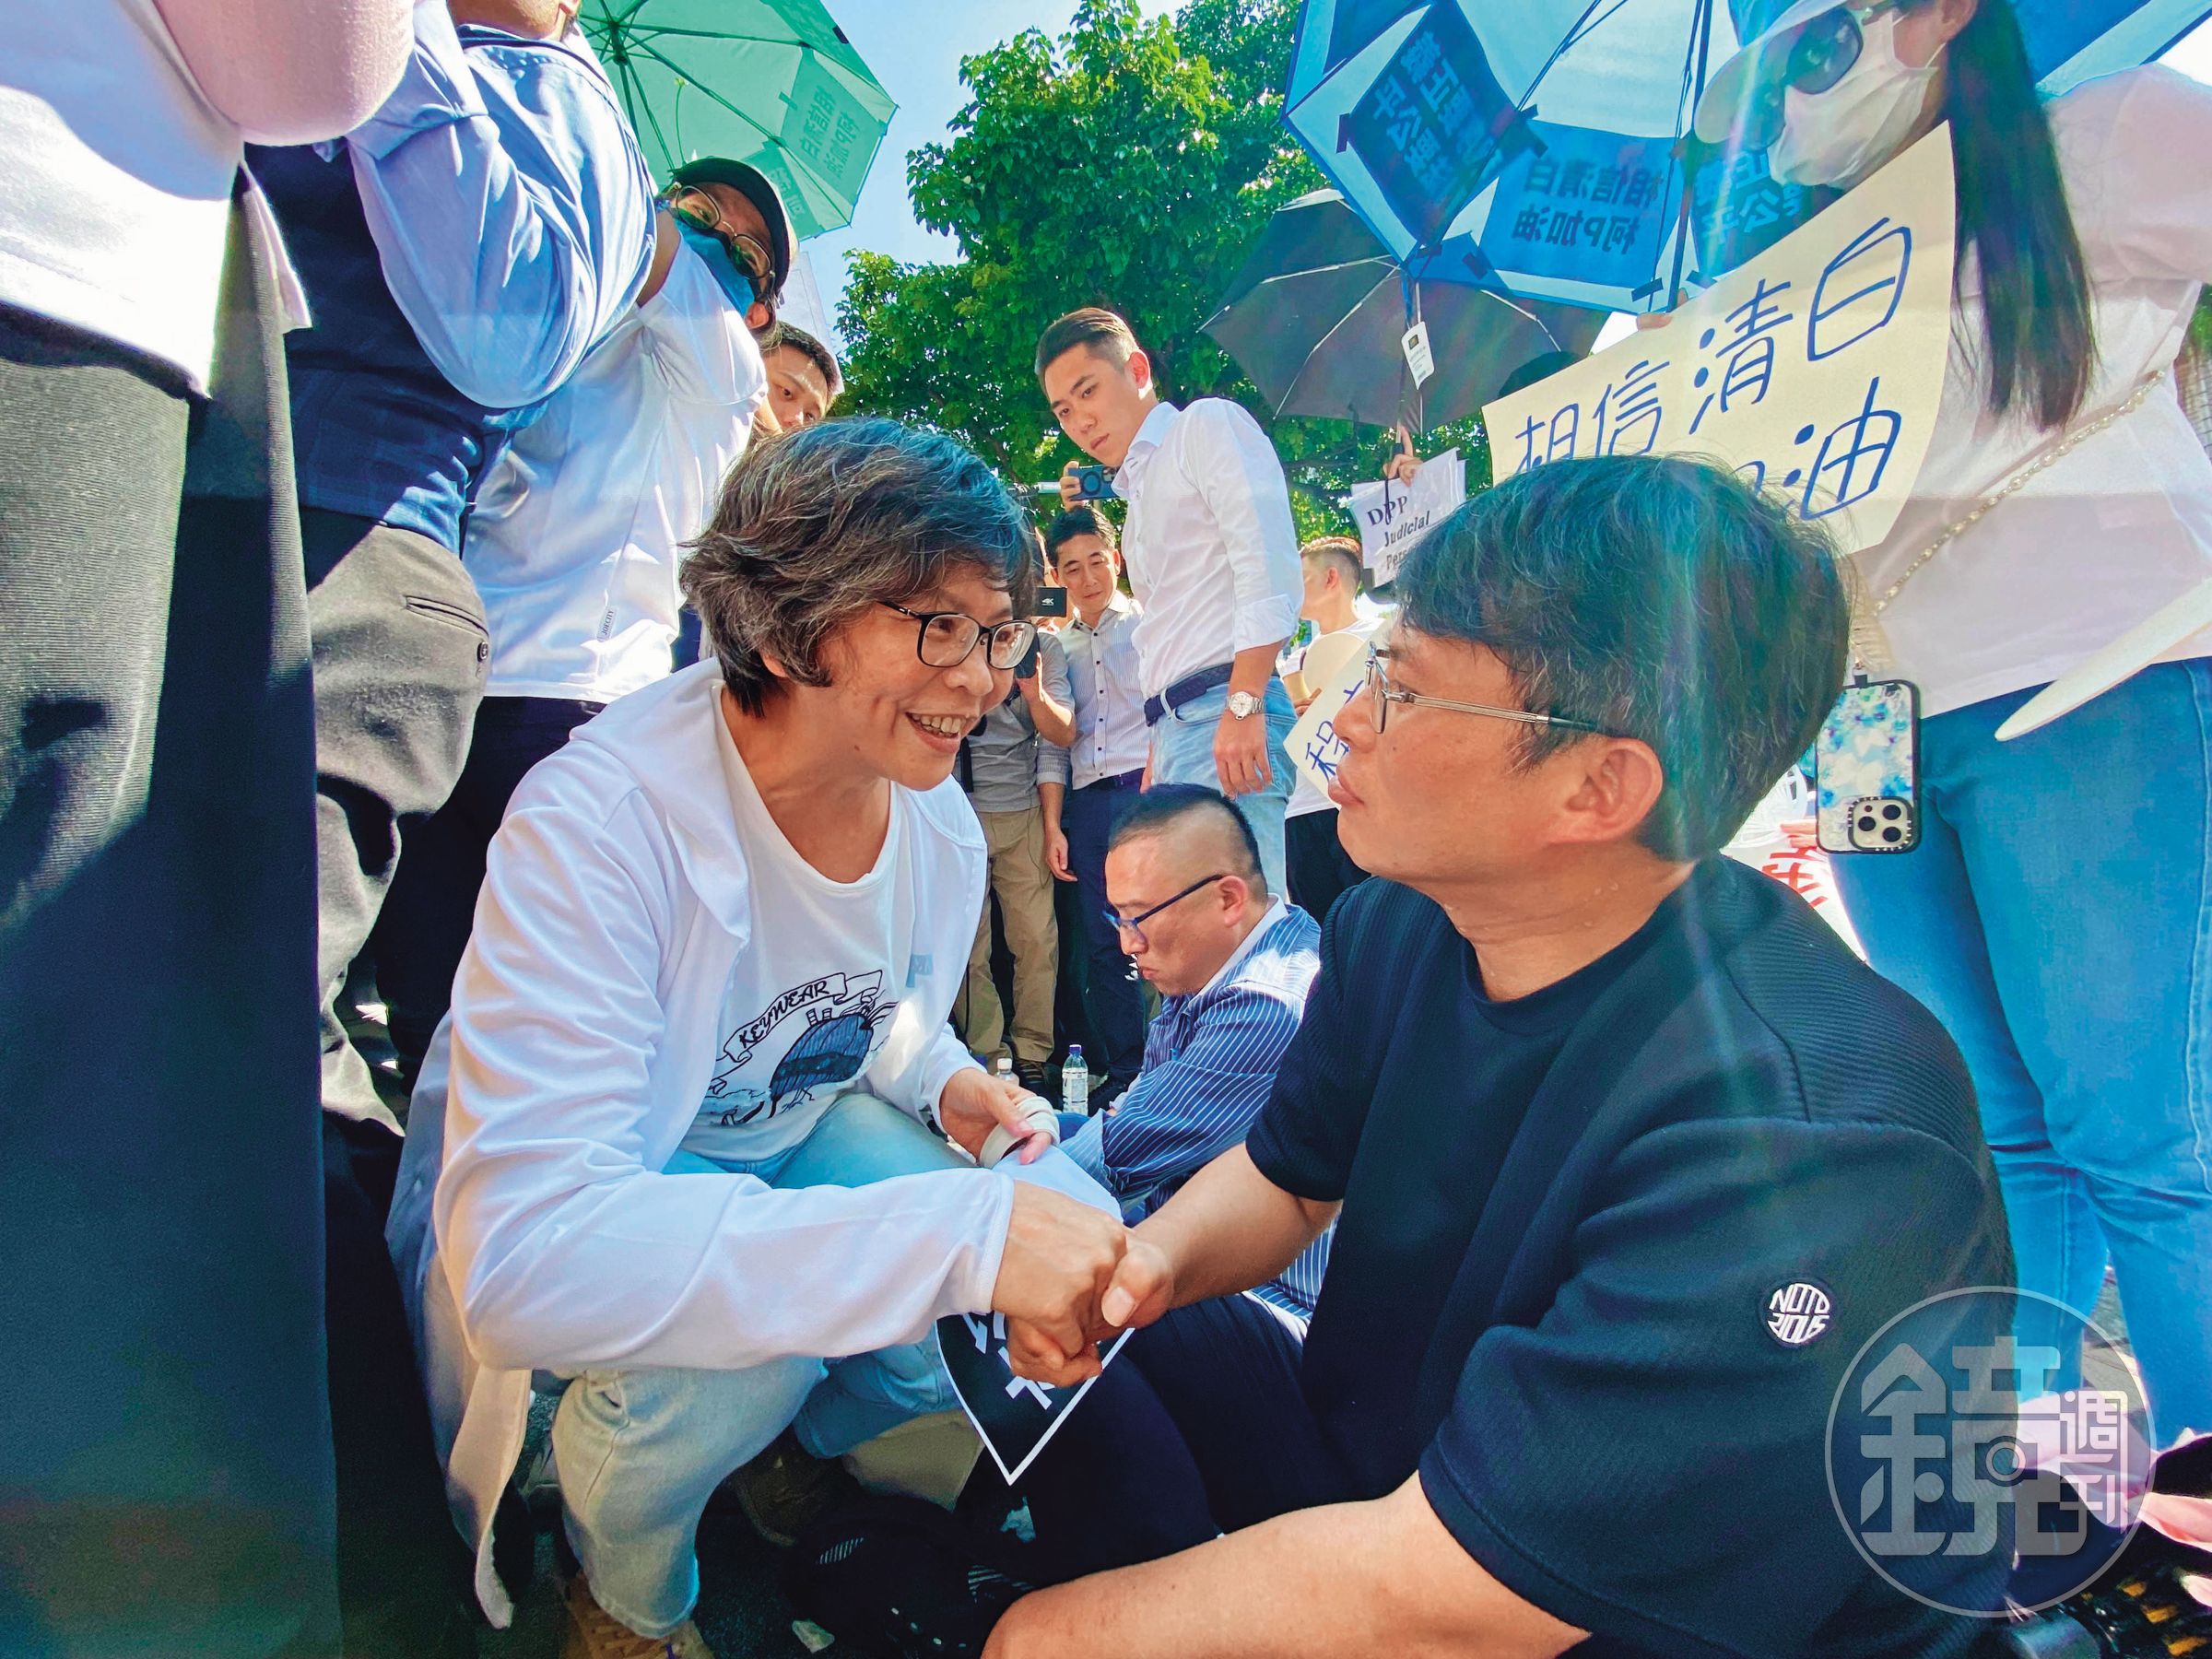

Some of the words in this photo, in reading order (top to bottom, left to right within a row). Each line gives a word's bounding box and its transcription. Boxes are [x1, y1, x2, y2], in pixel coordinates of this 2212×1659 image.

[1514, 218, 1912, 474] 相信清白
[1367, 496, 1407, 526] DPP
[1384, 510, 1430, 547] Judicial
[739, 981, 830, 1049] KEYWEAR
